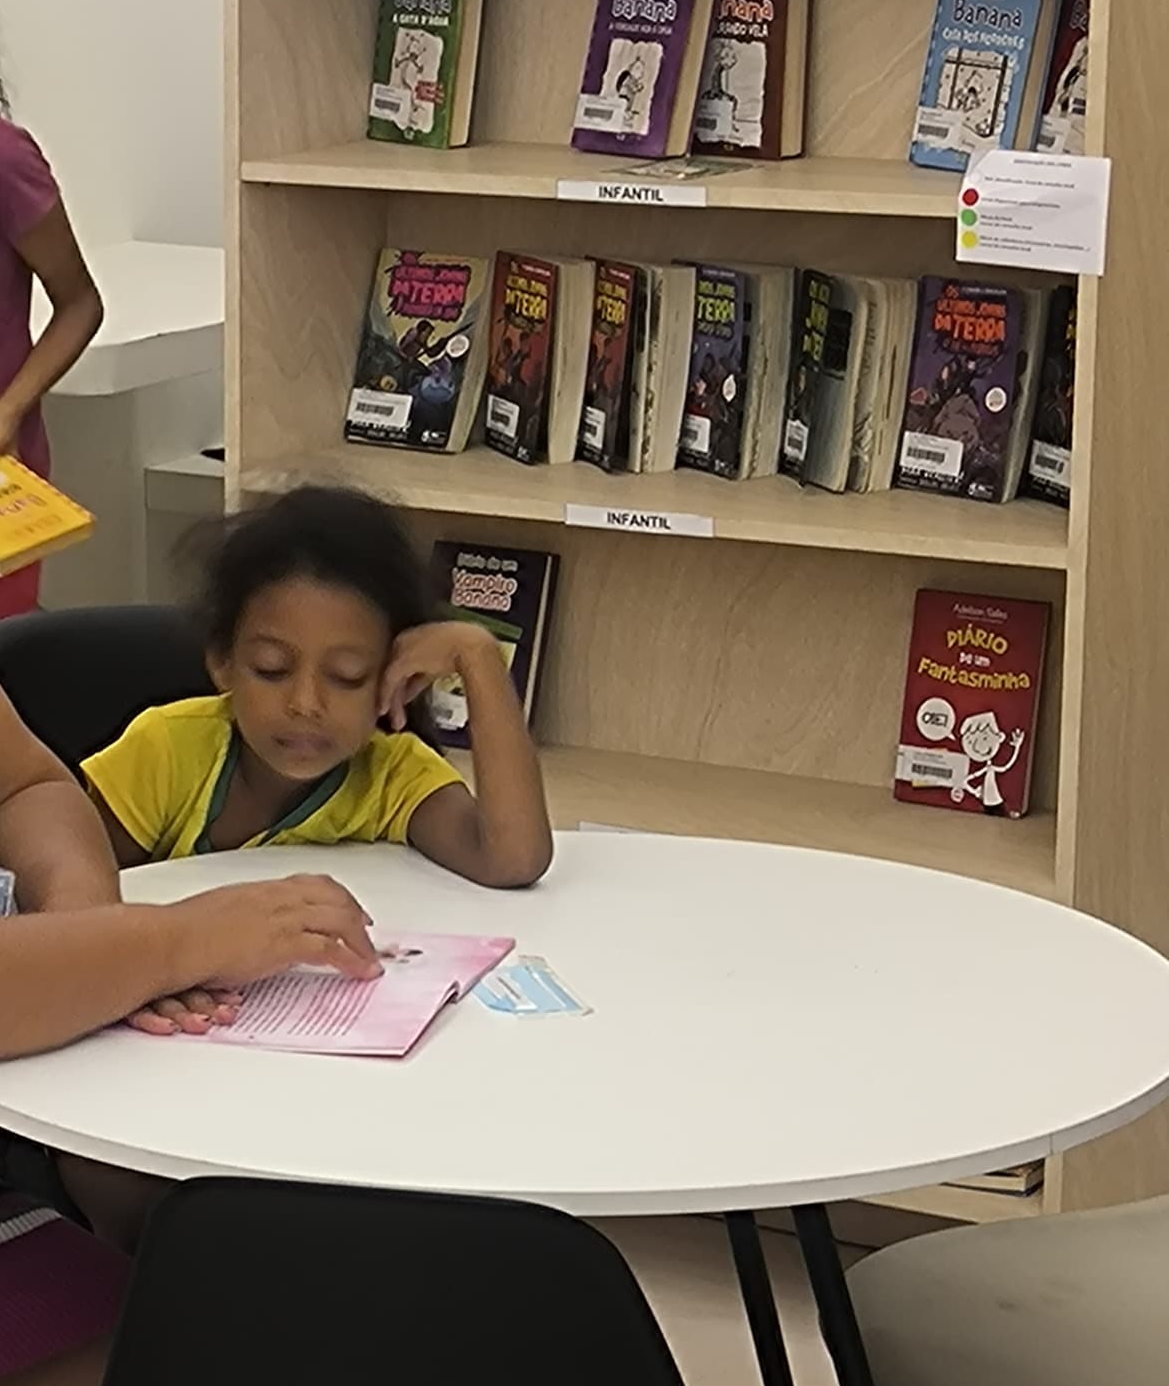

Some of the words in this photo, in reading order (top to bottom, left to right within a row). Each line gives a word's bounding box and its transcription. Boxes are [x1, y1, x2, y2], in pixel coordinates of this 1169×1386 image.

[597, 186, 664, 203] INFANTIL
[410, 280, 466, 306] TERRA
[697, 295, 736, 323] TERRA
[952, 315, 1006, 342] TERRA
[606, 512, 672, 530] INFANTIL
[452, 567, 519, 597] Vampiro
[451, 589, 512, 612] Banana
[946, 622, 1009, 655] DIÁRIO
[917, 656, 1031, 690] Fantasminha
